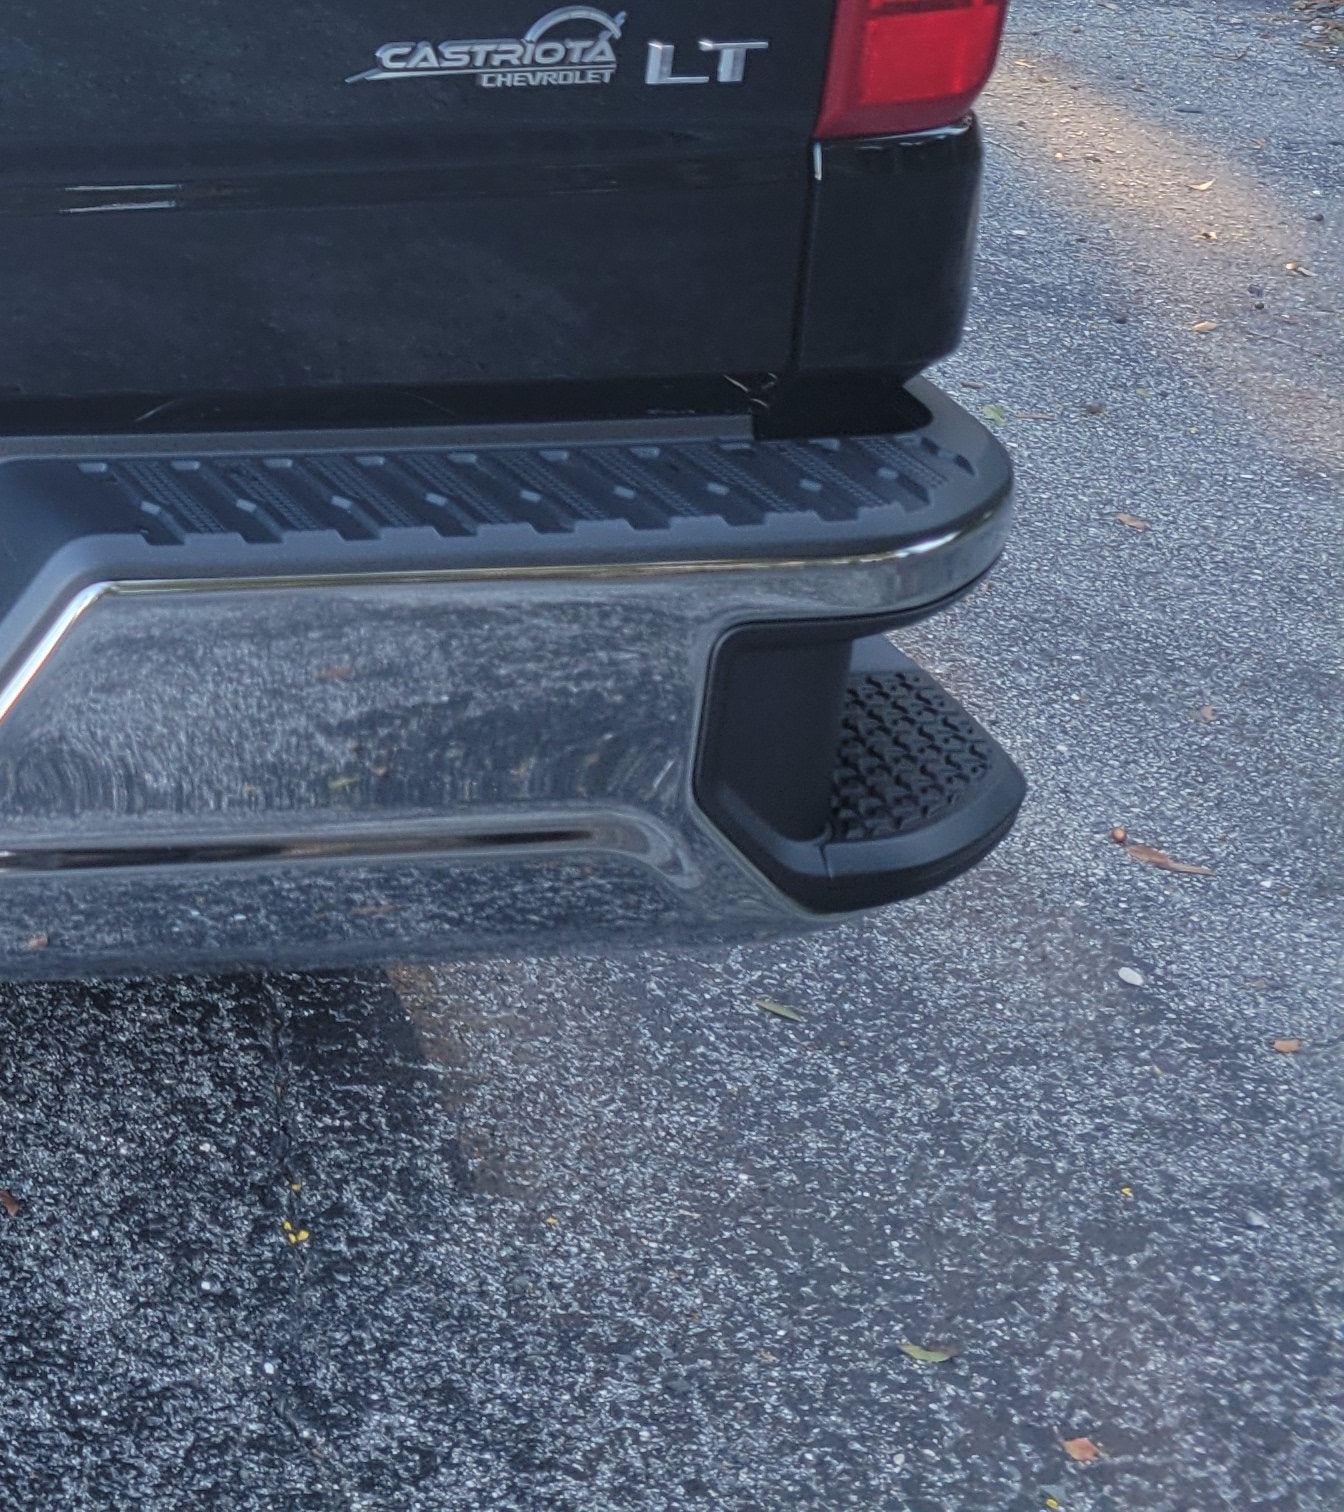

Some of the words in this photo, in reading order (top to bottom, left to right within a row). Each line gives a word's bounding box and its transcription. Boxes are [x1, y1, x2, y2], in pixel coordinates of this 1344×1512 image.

[376, 39, 616, 70] CASTRIOTA
[645, 40, 769, 85] LT
[480, 69, 615, 88] CHEVROLET
